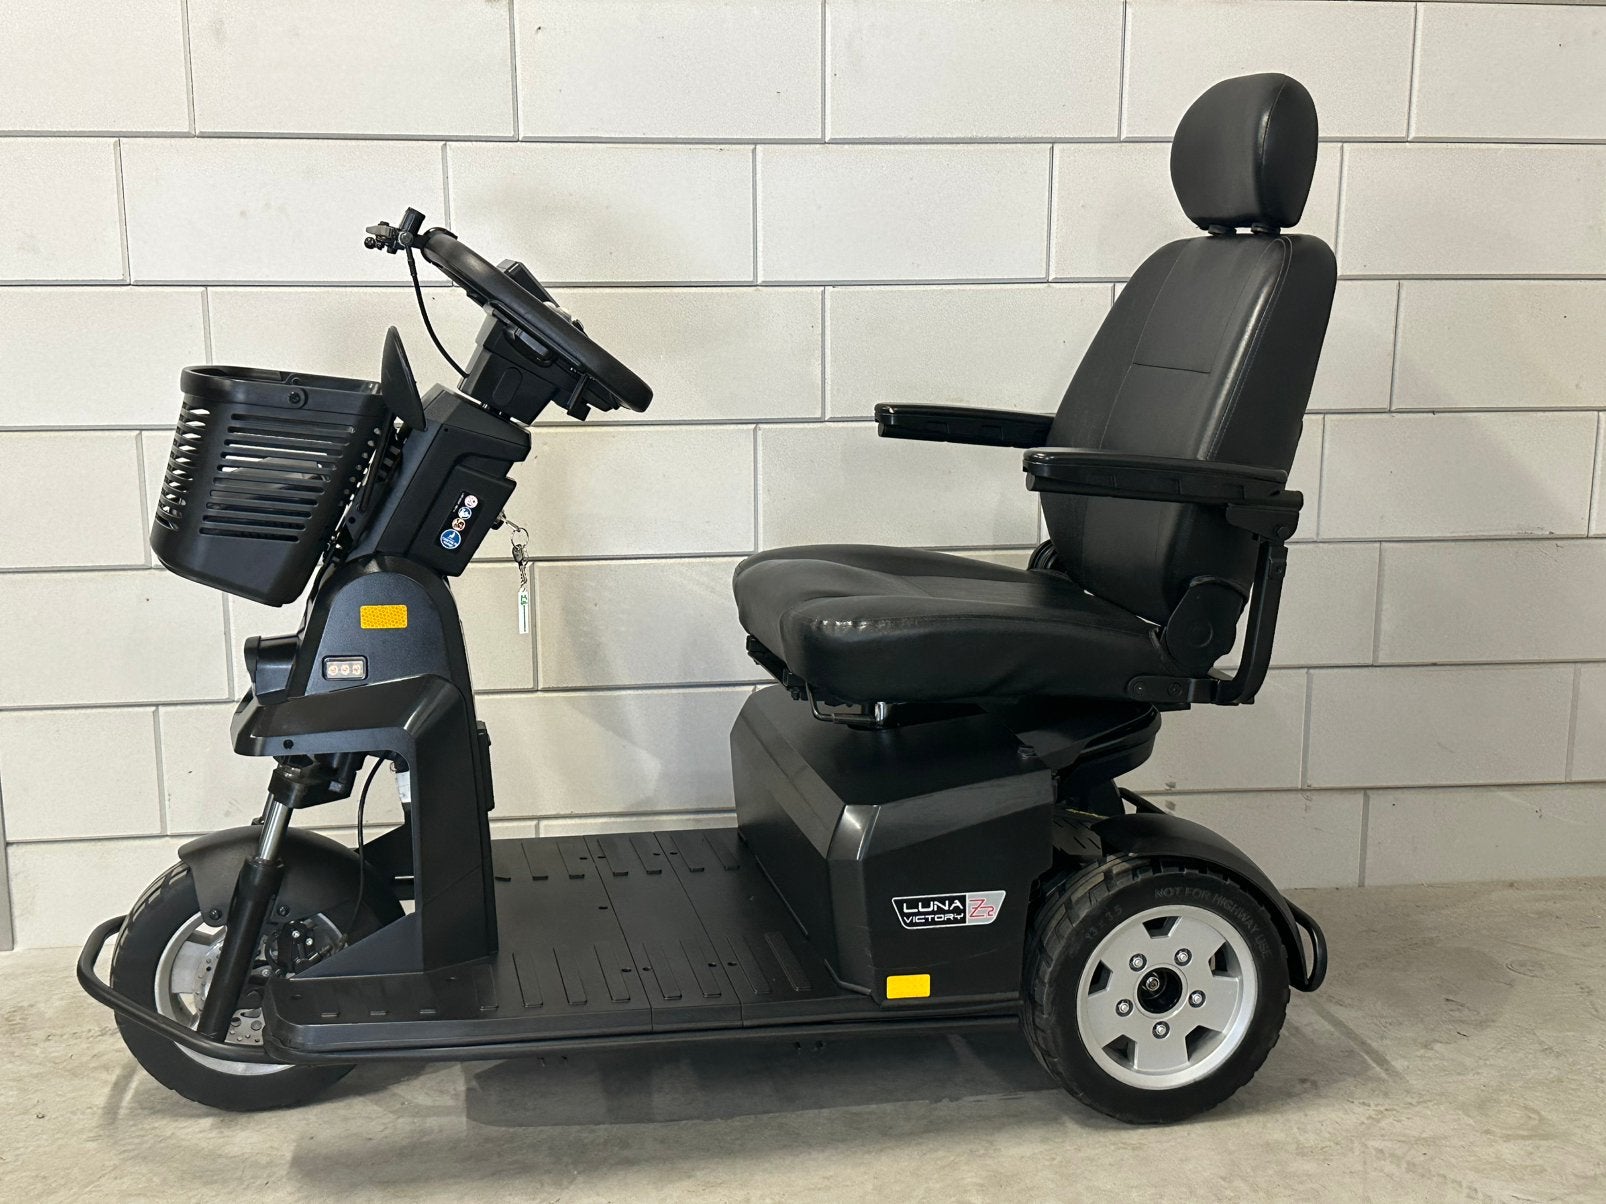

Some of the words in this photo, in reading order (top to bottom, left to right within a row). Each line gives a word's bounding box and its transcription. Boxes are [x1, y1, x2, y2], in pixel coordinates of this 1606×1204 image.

[903, 900, 963, 913] LUNA
[903, 913, 964, 924] VICTORY
[1154, 886, 1184, 898] NOT
[1185, 886, 1211, 899] FOR
[1211, 893, 1261, 934] HIGHWAY
[1254, 934, 1273, 960] USE
